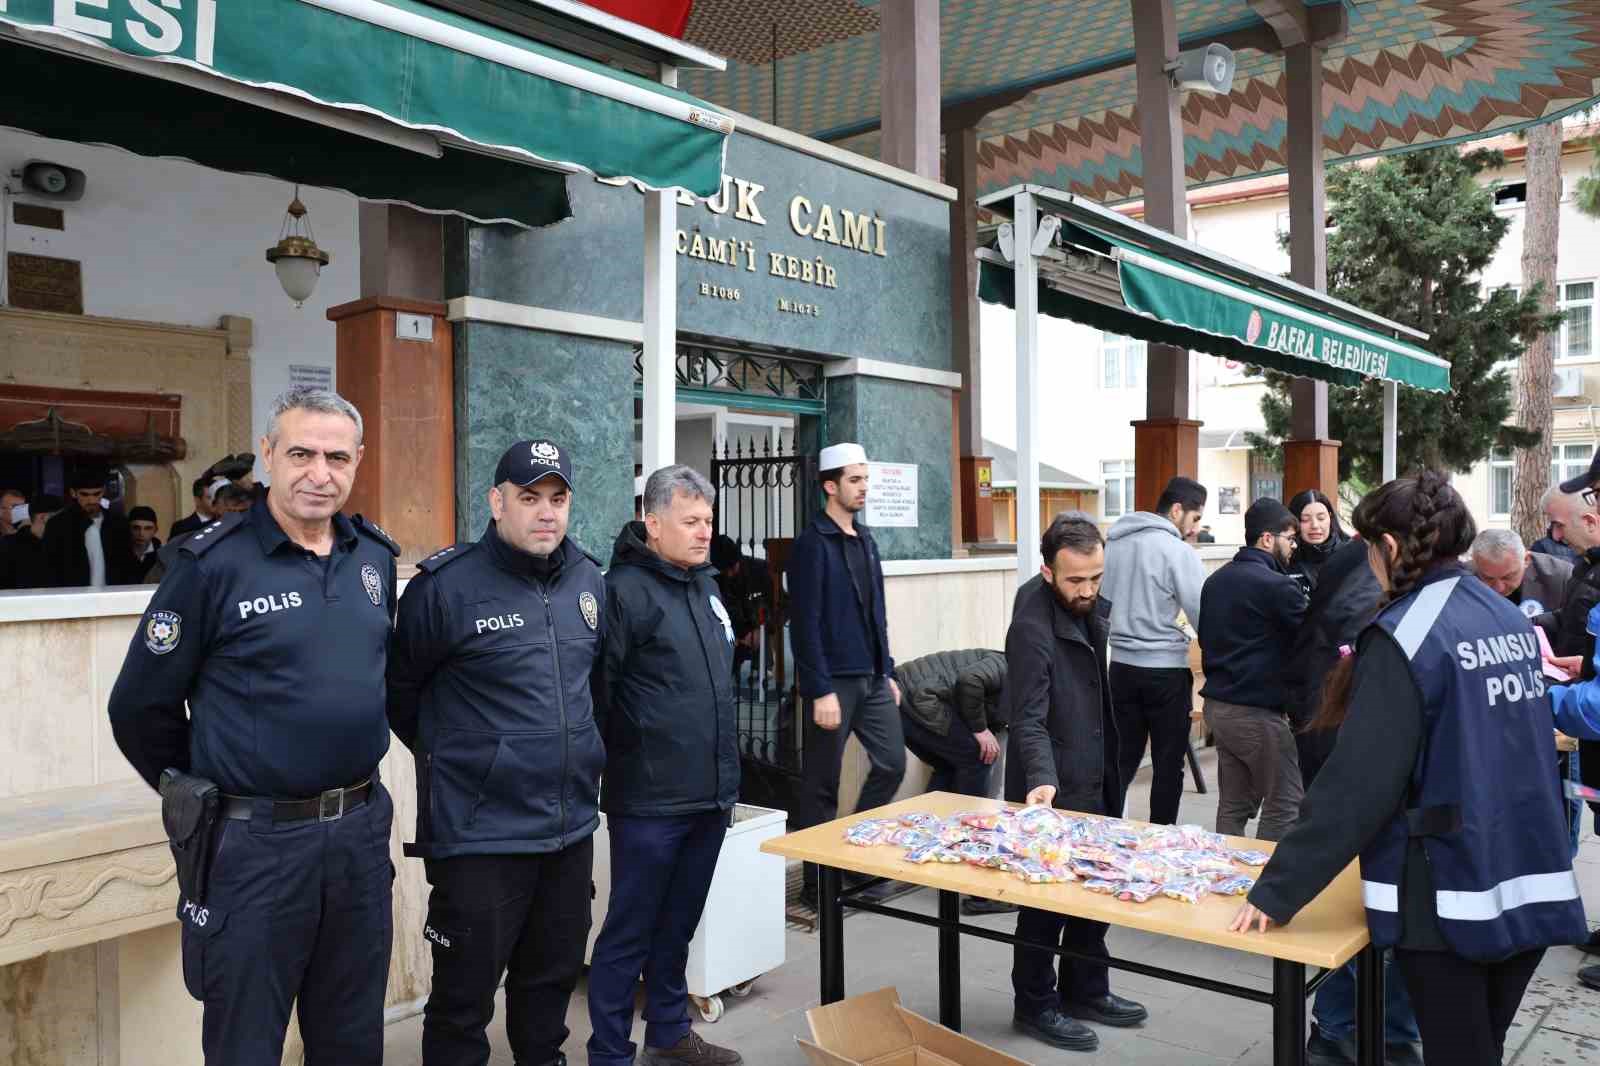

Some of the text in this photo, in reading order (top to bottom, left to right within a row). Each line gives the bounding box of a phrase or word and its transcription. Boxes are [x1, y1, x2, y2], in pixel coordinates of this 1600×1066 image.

[412, 319, 419, 334] 1
[1267, 321, 1318, 361] BAFRA
[1456, 632, 1538, 670] SAMSU
